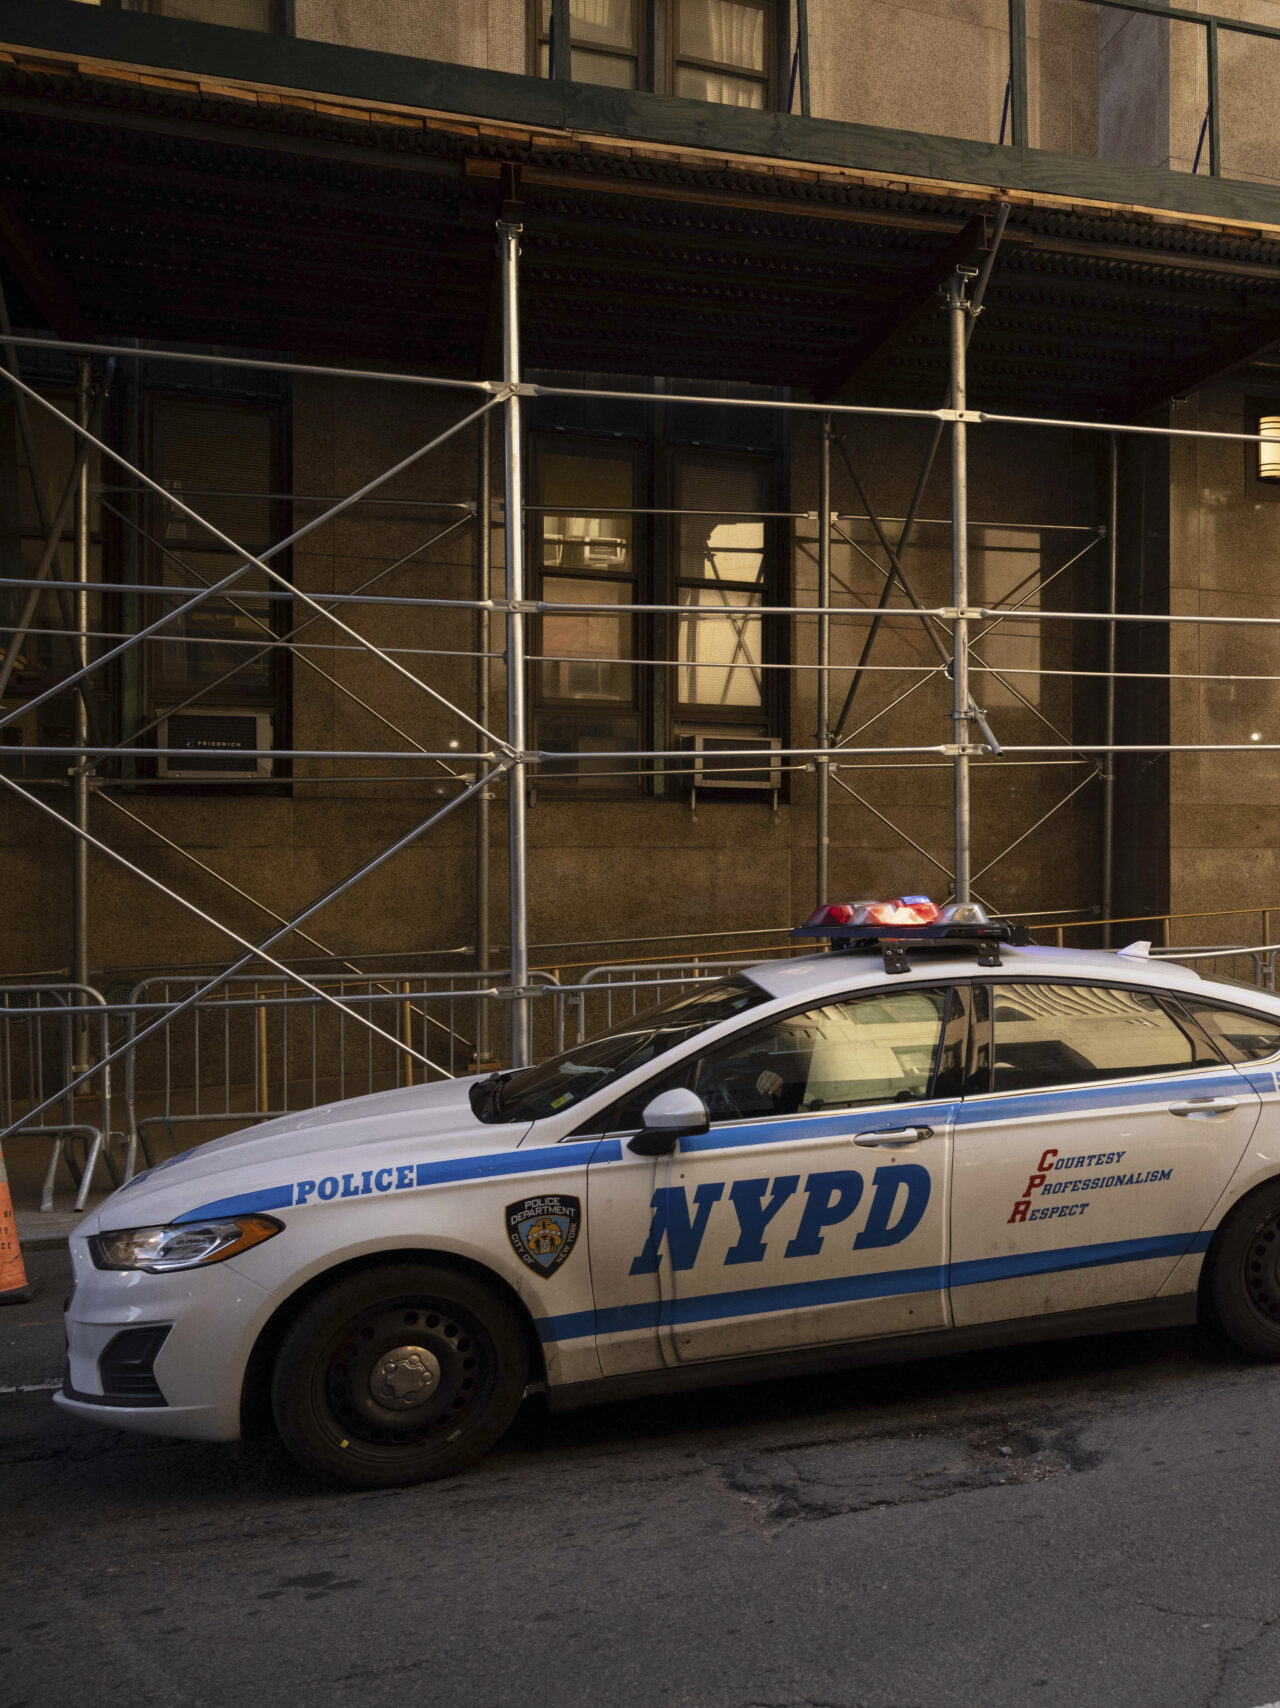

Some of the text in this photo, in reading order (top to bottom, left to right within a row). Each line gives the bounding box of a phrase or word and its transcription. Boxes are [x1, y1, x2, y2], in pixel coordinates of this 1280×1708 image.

[295, 1165, 415, 1206] POLICE
[524, 1197, 561, 1210] POLICE
[511, 1206, 576, 1226] DEPARTMENT
[628, 1163, 932, 1276] NYPD
[511, 1233, 535, 1265] CITY OF
[556, 1222, 578, 1263] NEW YORK
